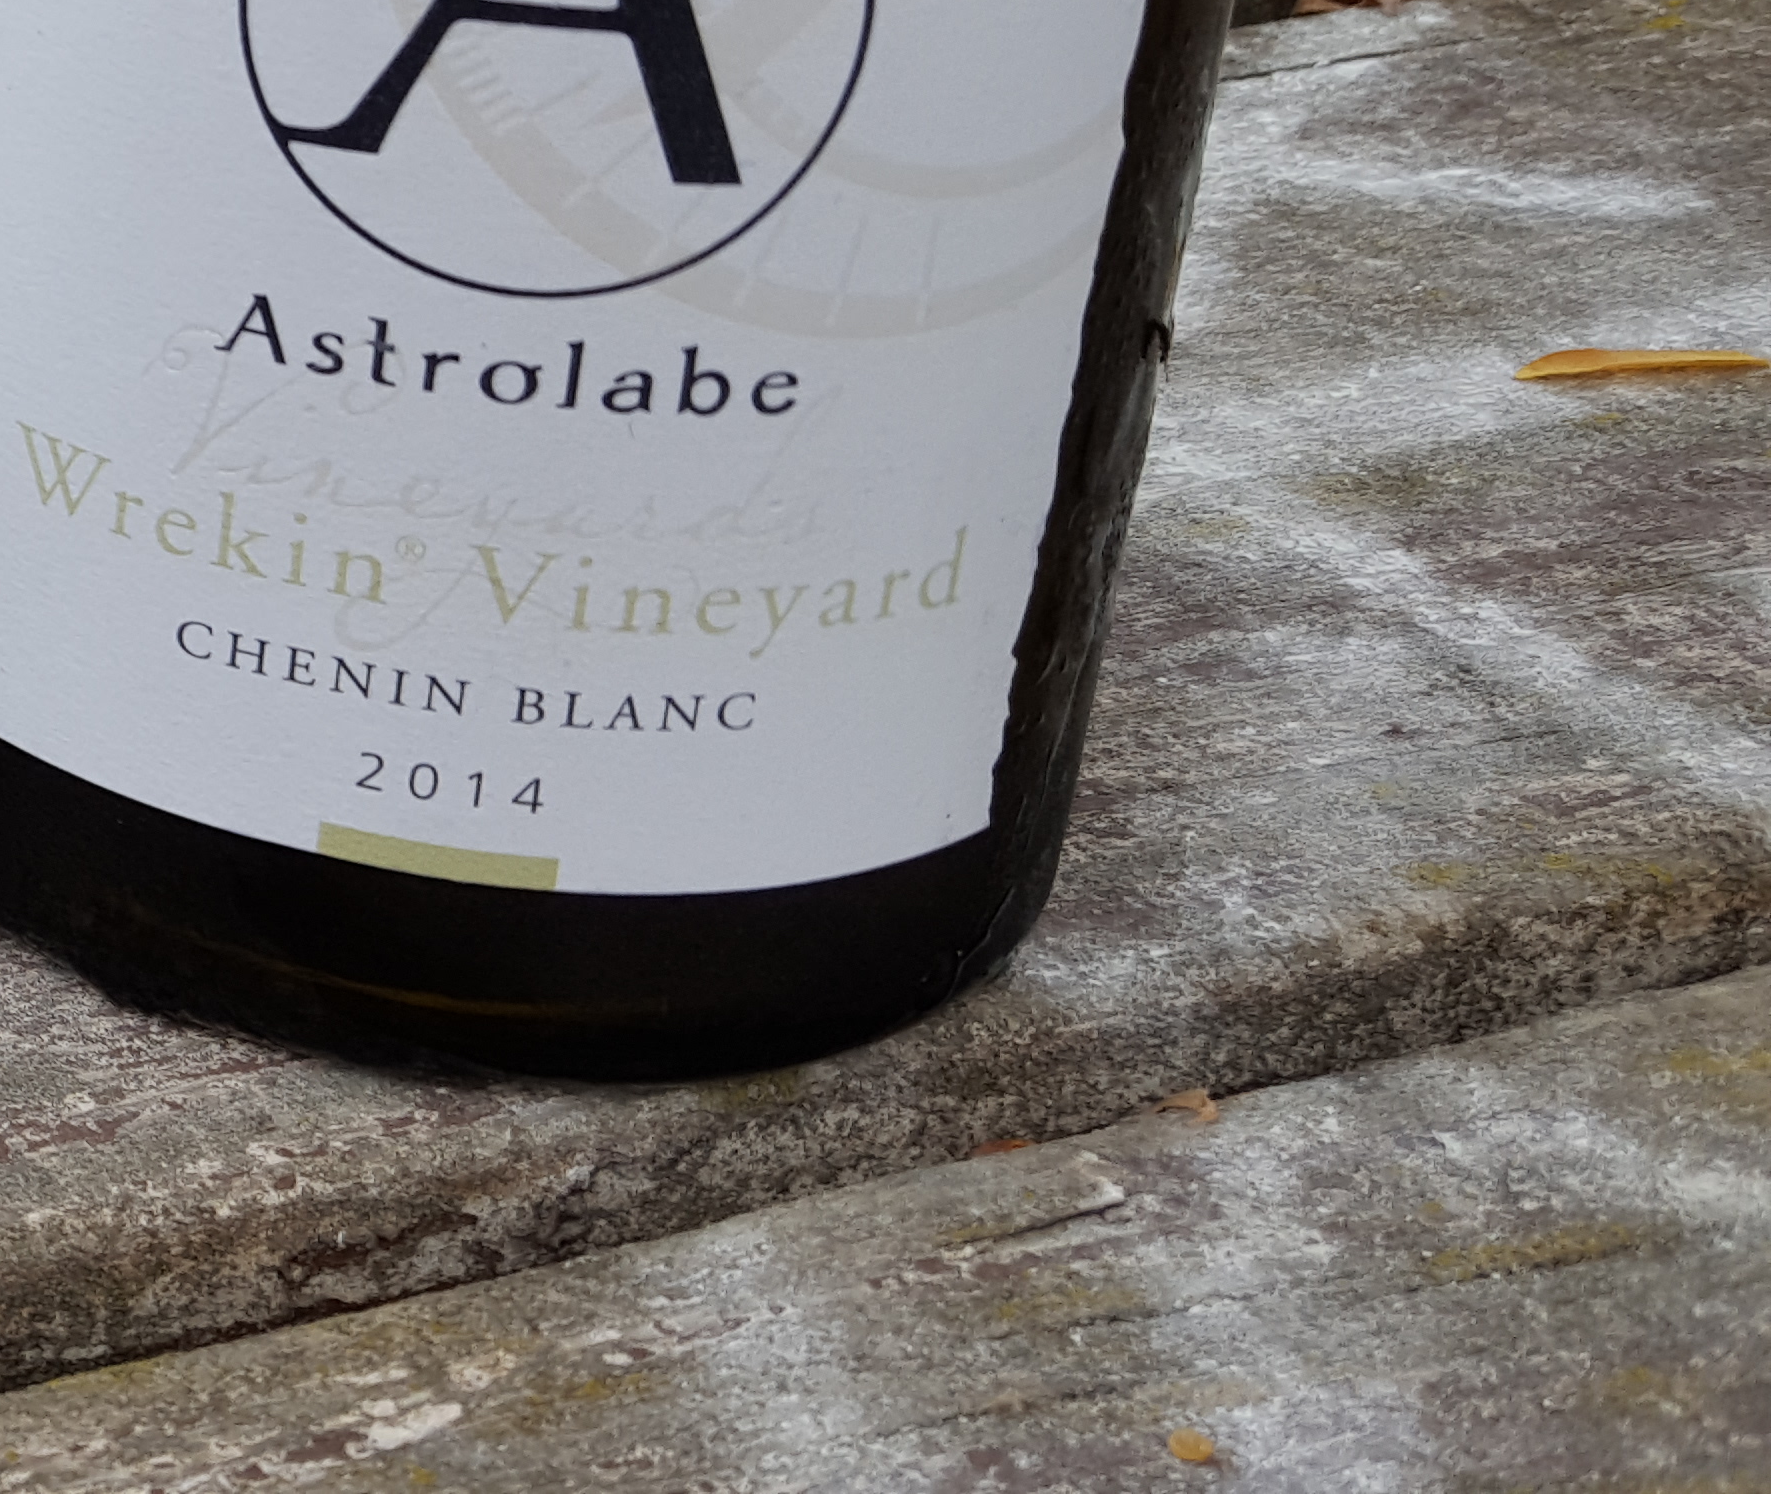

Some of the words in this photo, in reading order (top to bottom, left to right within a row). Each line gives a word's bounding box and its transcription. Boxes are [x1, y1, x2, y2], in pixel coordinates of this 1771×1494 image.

[213, 292, 801, 418] Astrolabe
[469, 525, 969, 659] Vineyard
[175, 619, 471, 717] CHENIN
[512, 686, 759, 732] BLANC
[355, 751, 546, 815] 2014
